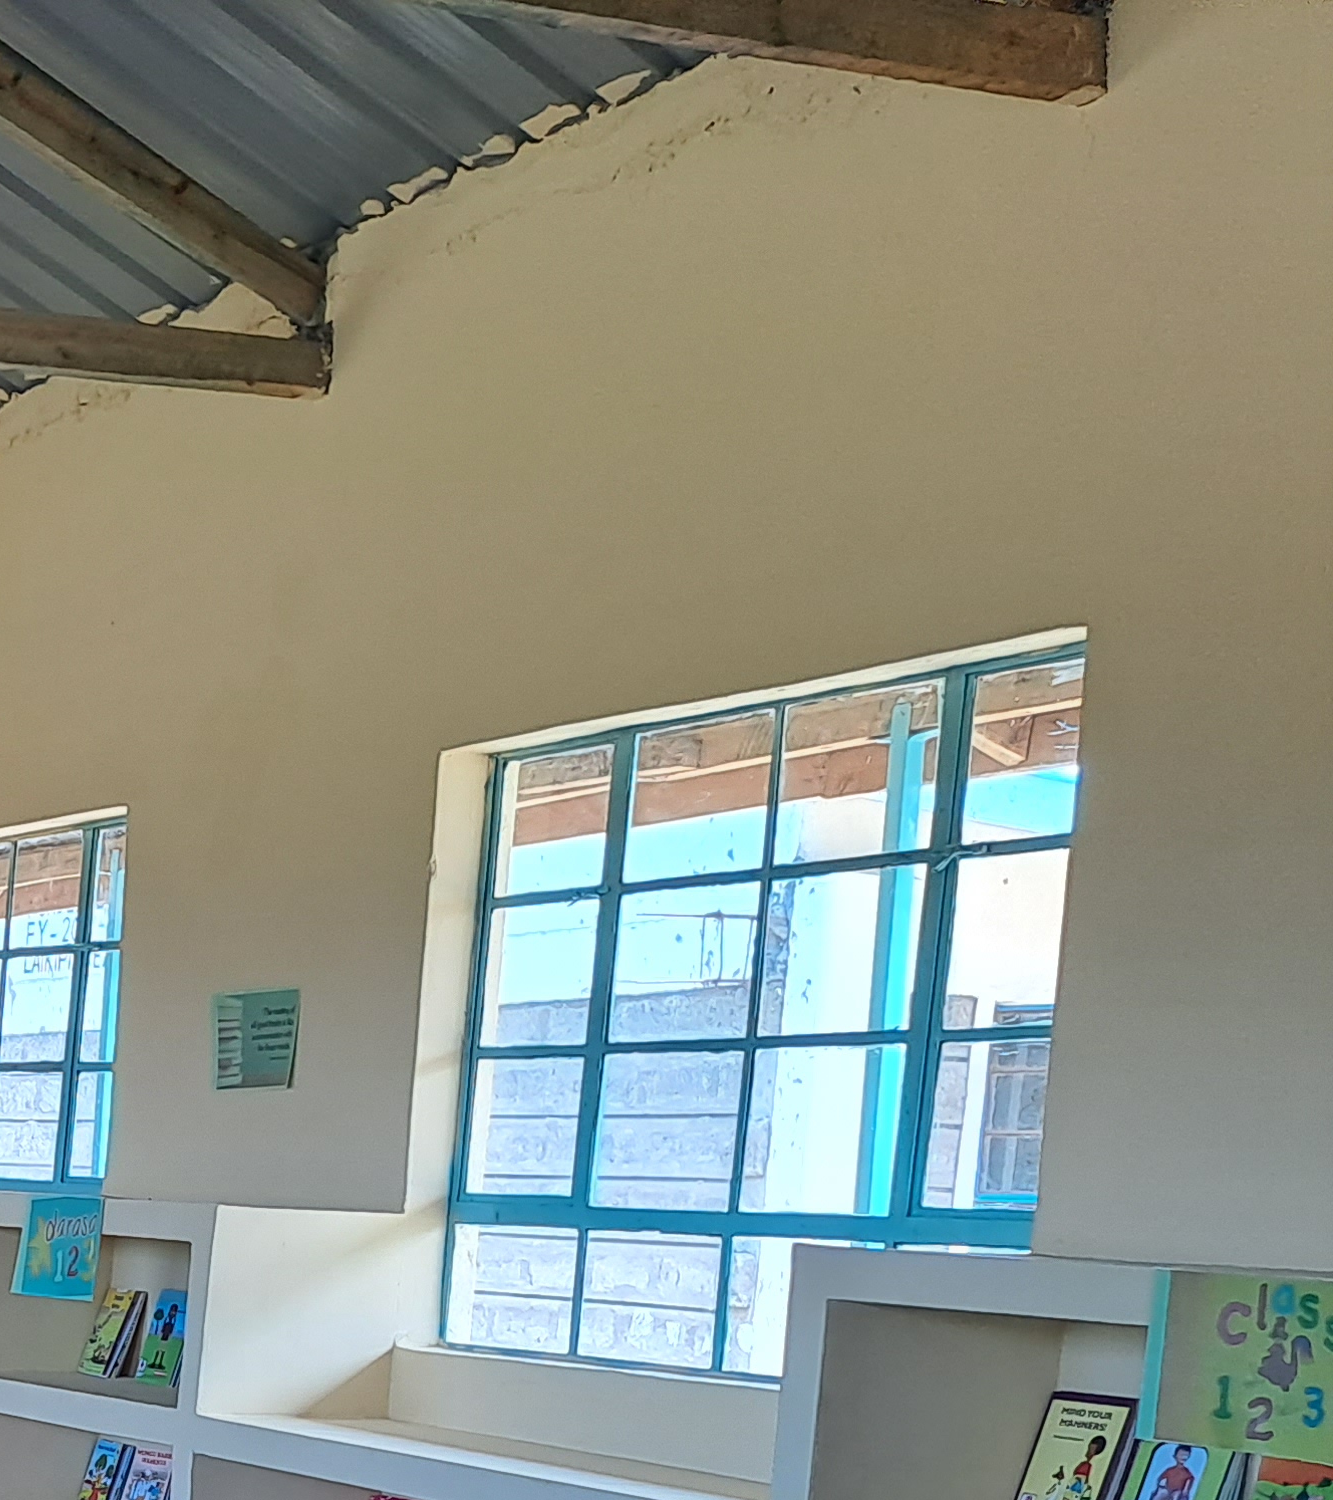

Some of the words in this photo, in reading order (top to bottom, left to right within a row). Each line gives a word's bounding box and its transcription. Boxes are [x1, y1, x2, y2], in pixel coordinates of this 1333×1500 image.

[46, 1210, 98, 1242] darasa
[67, 1246, 79, 1276] 2
[1087, 1410, 1113, 1420] YOUR
[1213, 1375, 1232, 1419] 1
[1246, 1397, 1274, 1441] 2
[1303, 1386, 1325, 1428] 3
